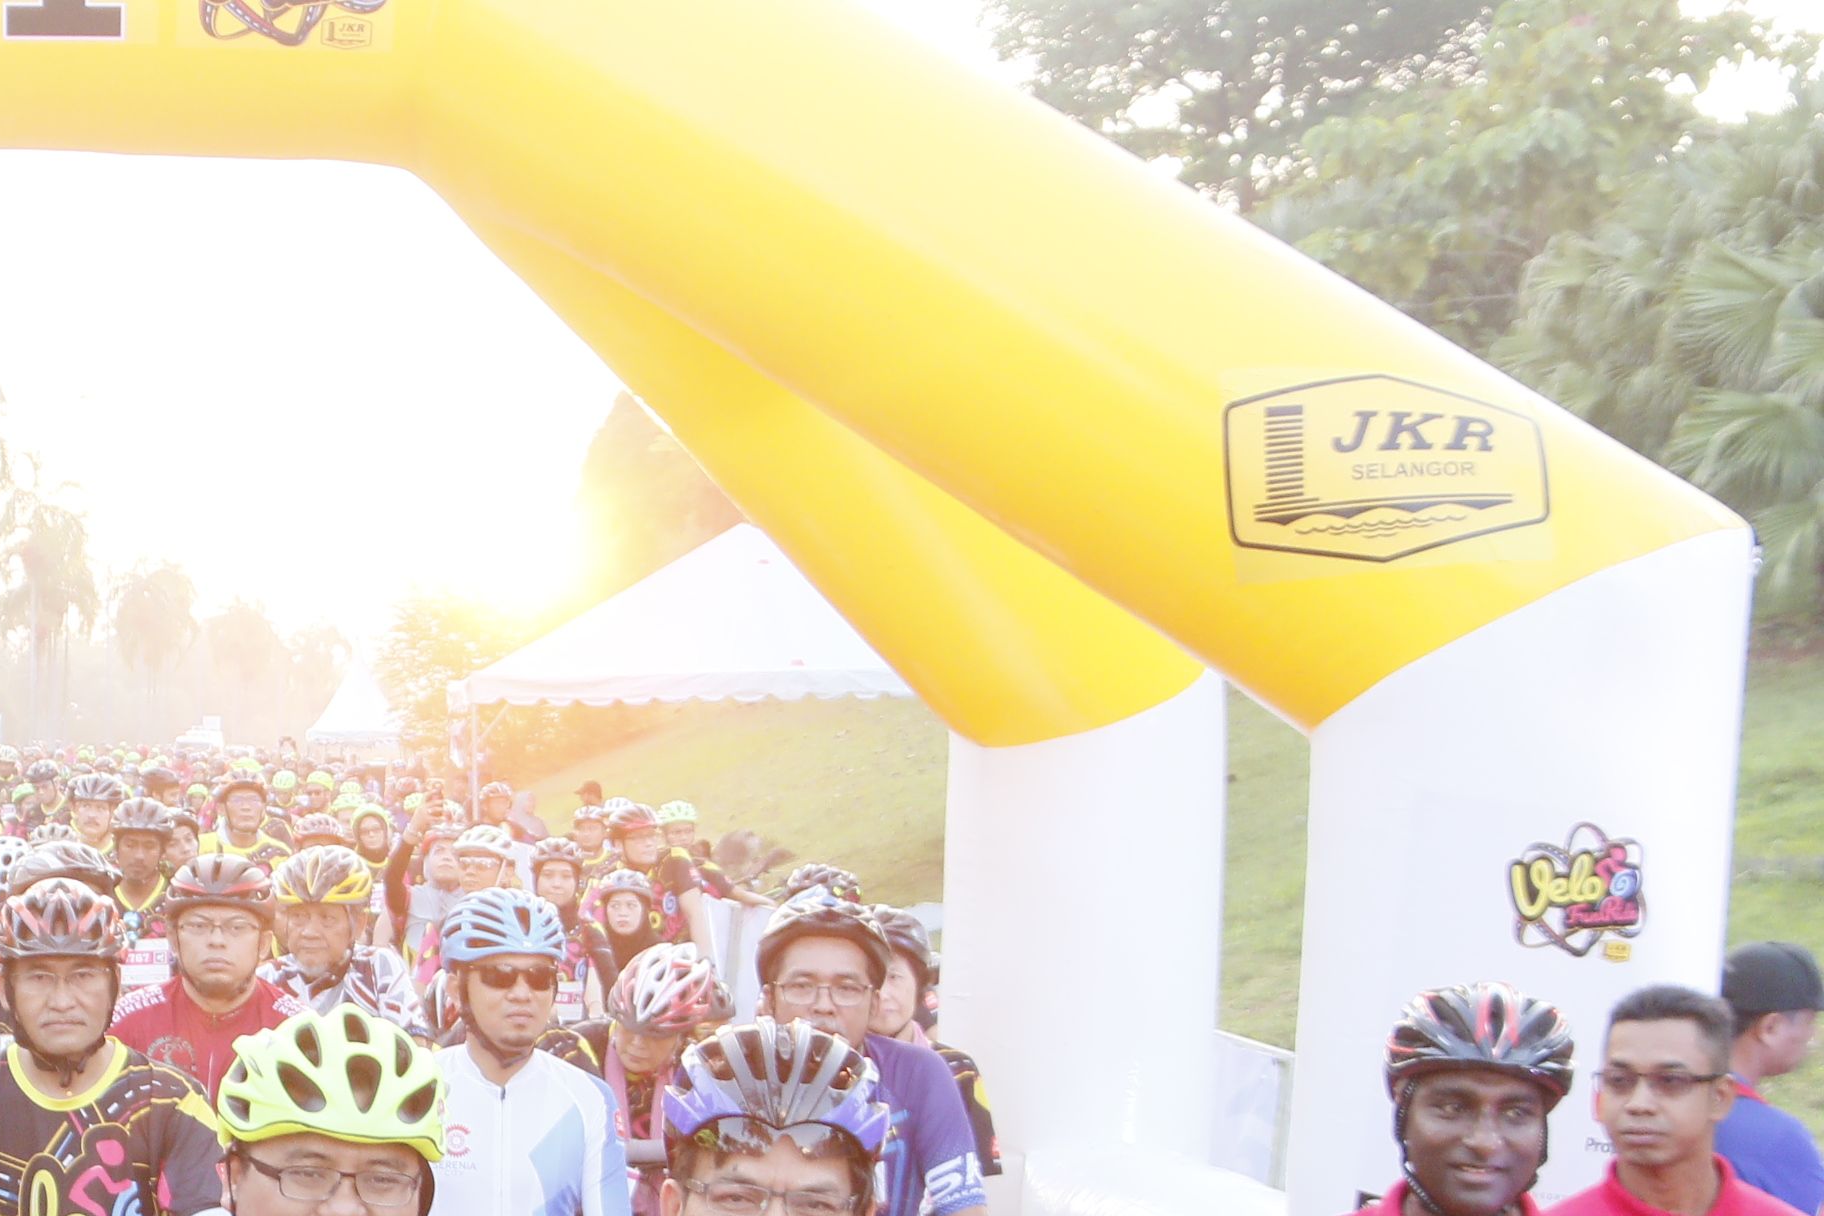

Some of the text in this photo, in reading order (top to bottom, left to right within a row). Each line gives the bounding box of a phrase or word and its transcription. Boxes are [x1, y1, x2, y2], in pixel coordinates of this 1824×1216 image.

[1331, 411, 1494, 453] JKR
[1351, 461, 1476, 481] SELANGOR
[1510, 853, 1605, 921] Velo
